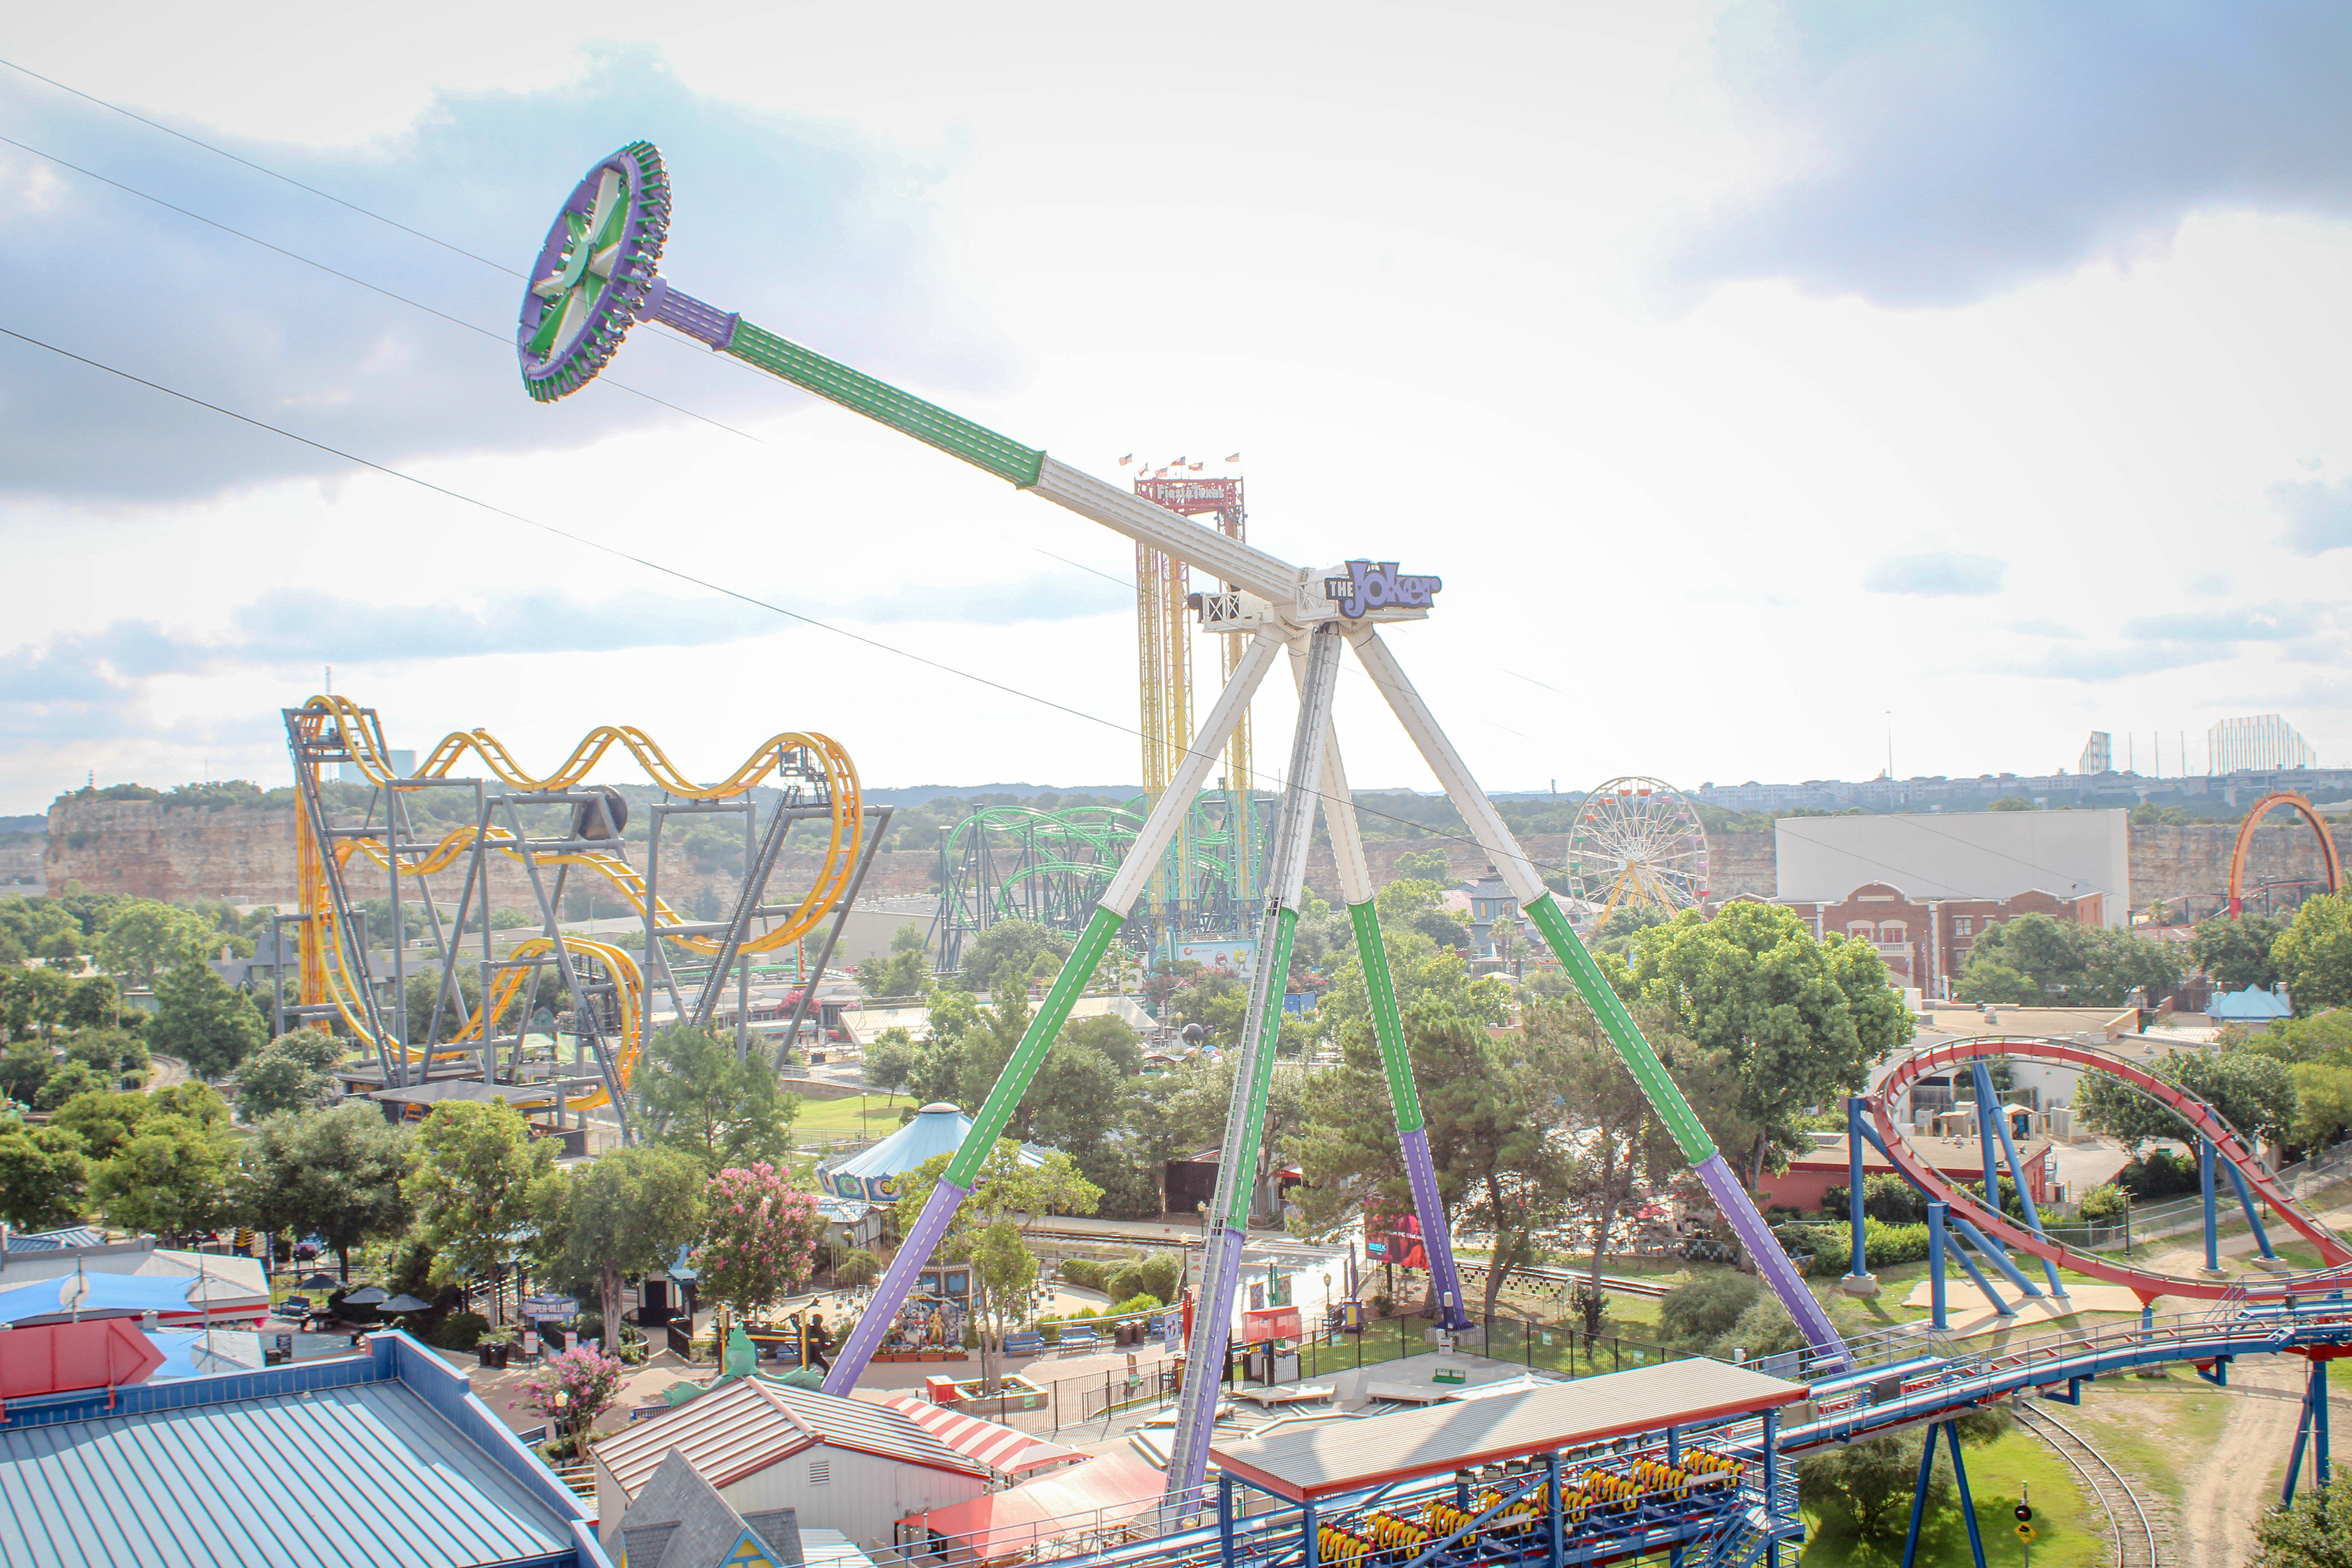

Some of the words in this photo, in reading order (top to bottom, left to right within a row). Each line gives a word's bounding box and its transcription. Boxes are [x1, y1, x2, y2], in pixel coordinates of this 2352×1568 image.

[1157, 485, 1192, 499] Fiesta
[1192, 484, 1224, 499] Texas
[1330, 581, 1354, 597] THE
